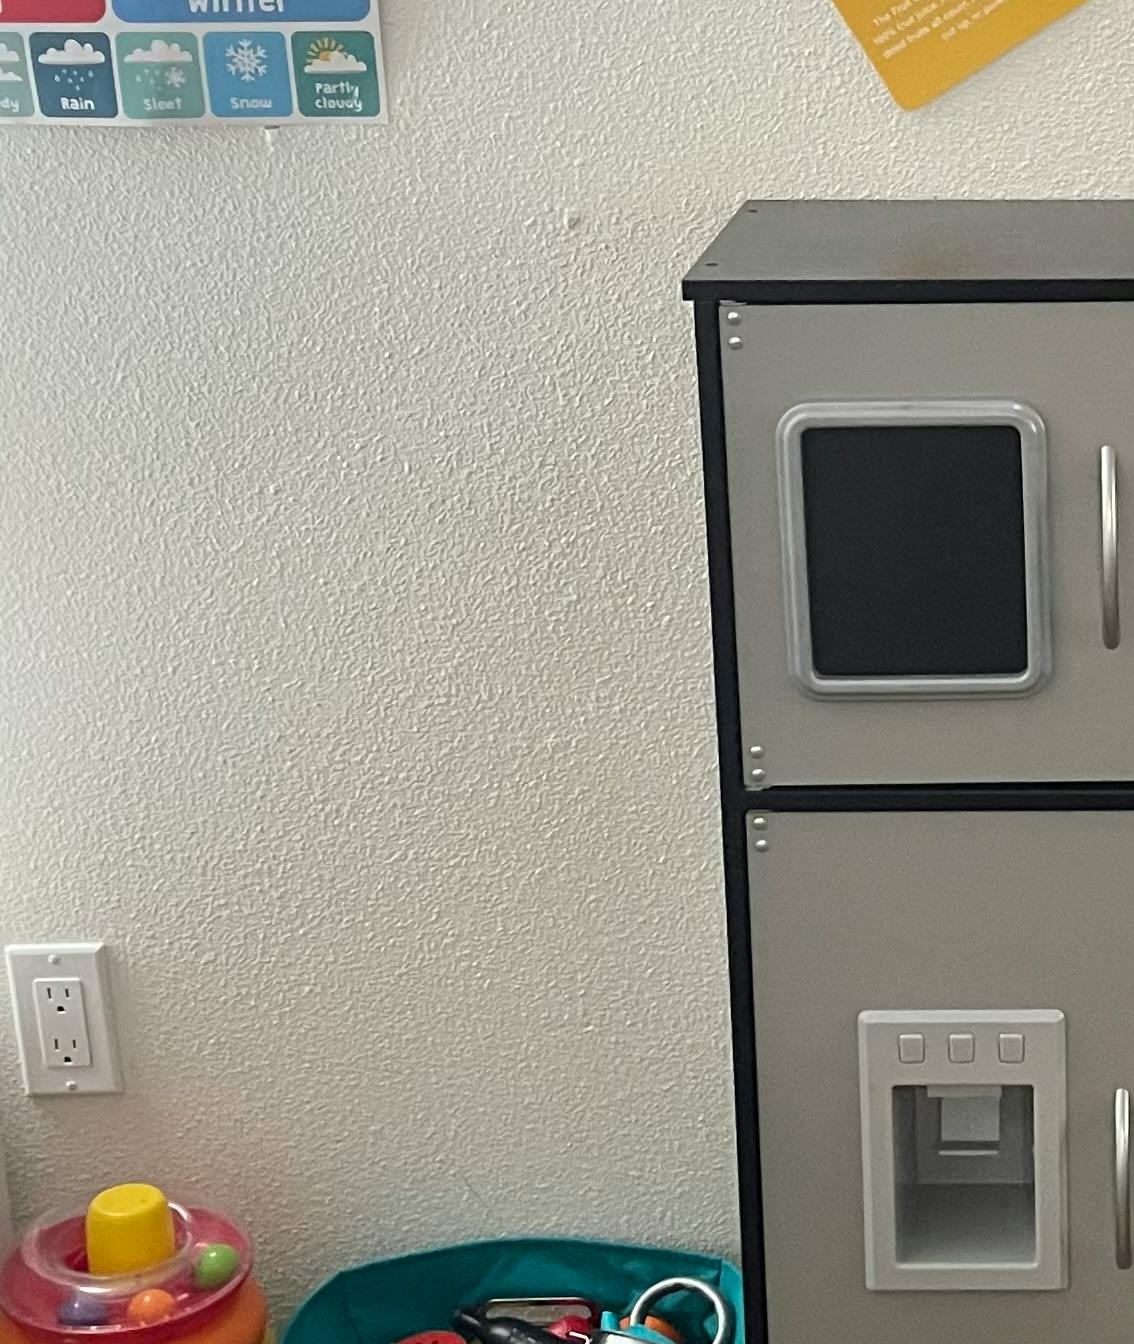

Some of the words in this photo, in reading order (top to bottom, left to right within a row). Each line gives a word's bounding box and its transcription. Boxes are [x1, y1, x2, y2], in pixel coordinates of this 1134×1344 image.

[60, 97, 96, 111] Rain
[144, 96, 183, 111] Sleet
[230, 97, 273, 110] Snow
[315, 96, 363, 113] cloudy
